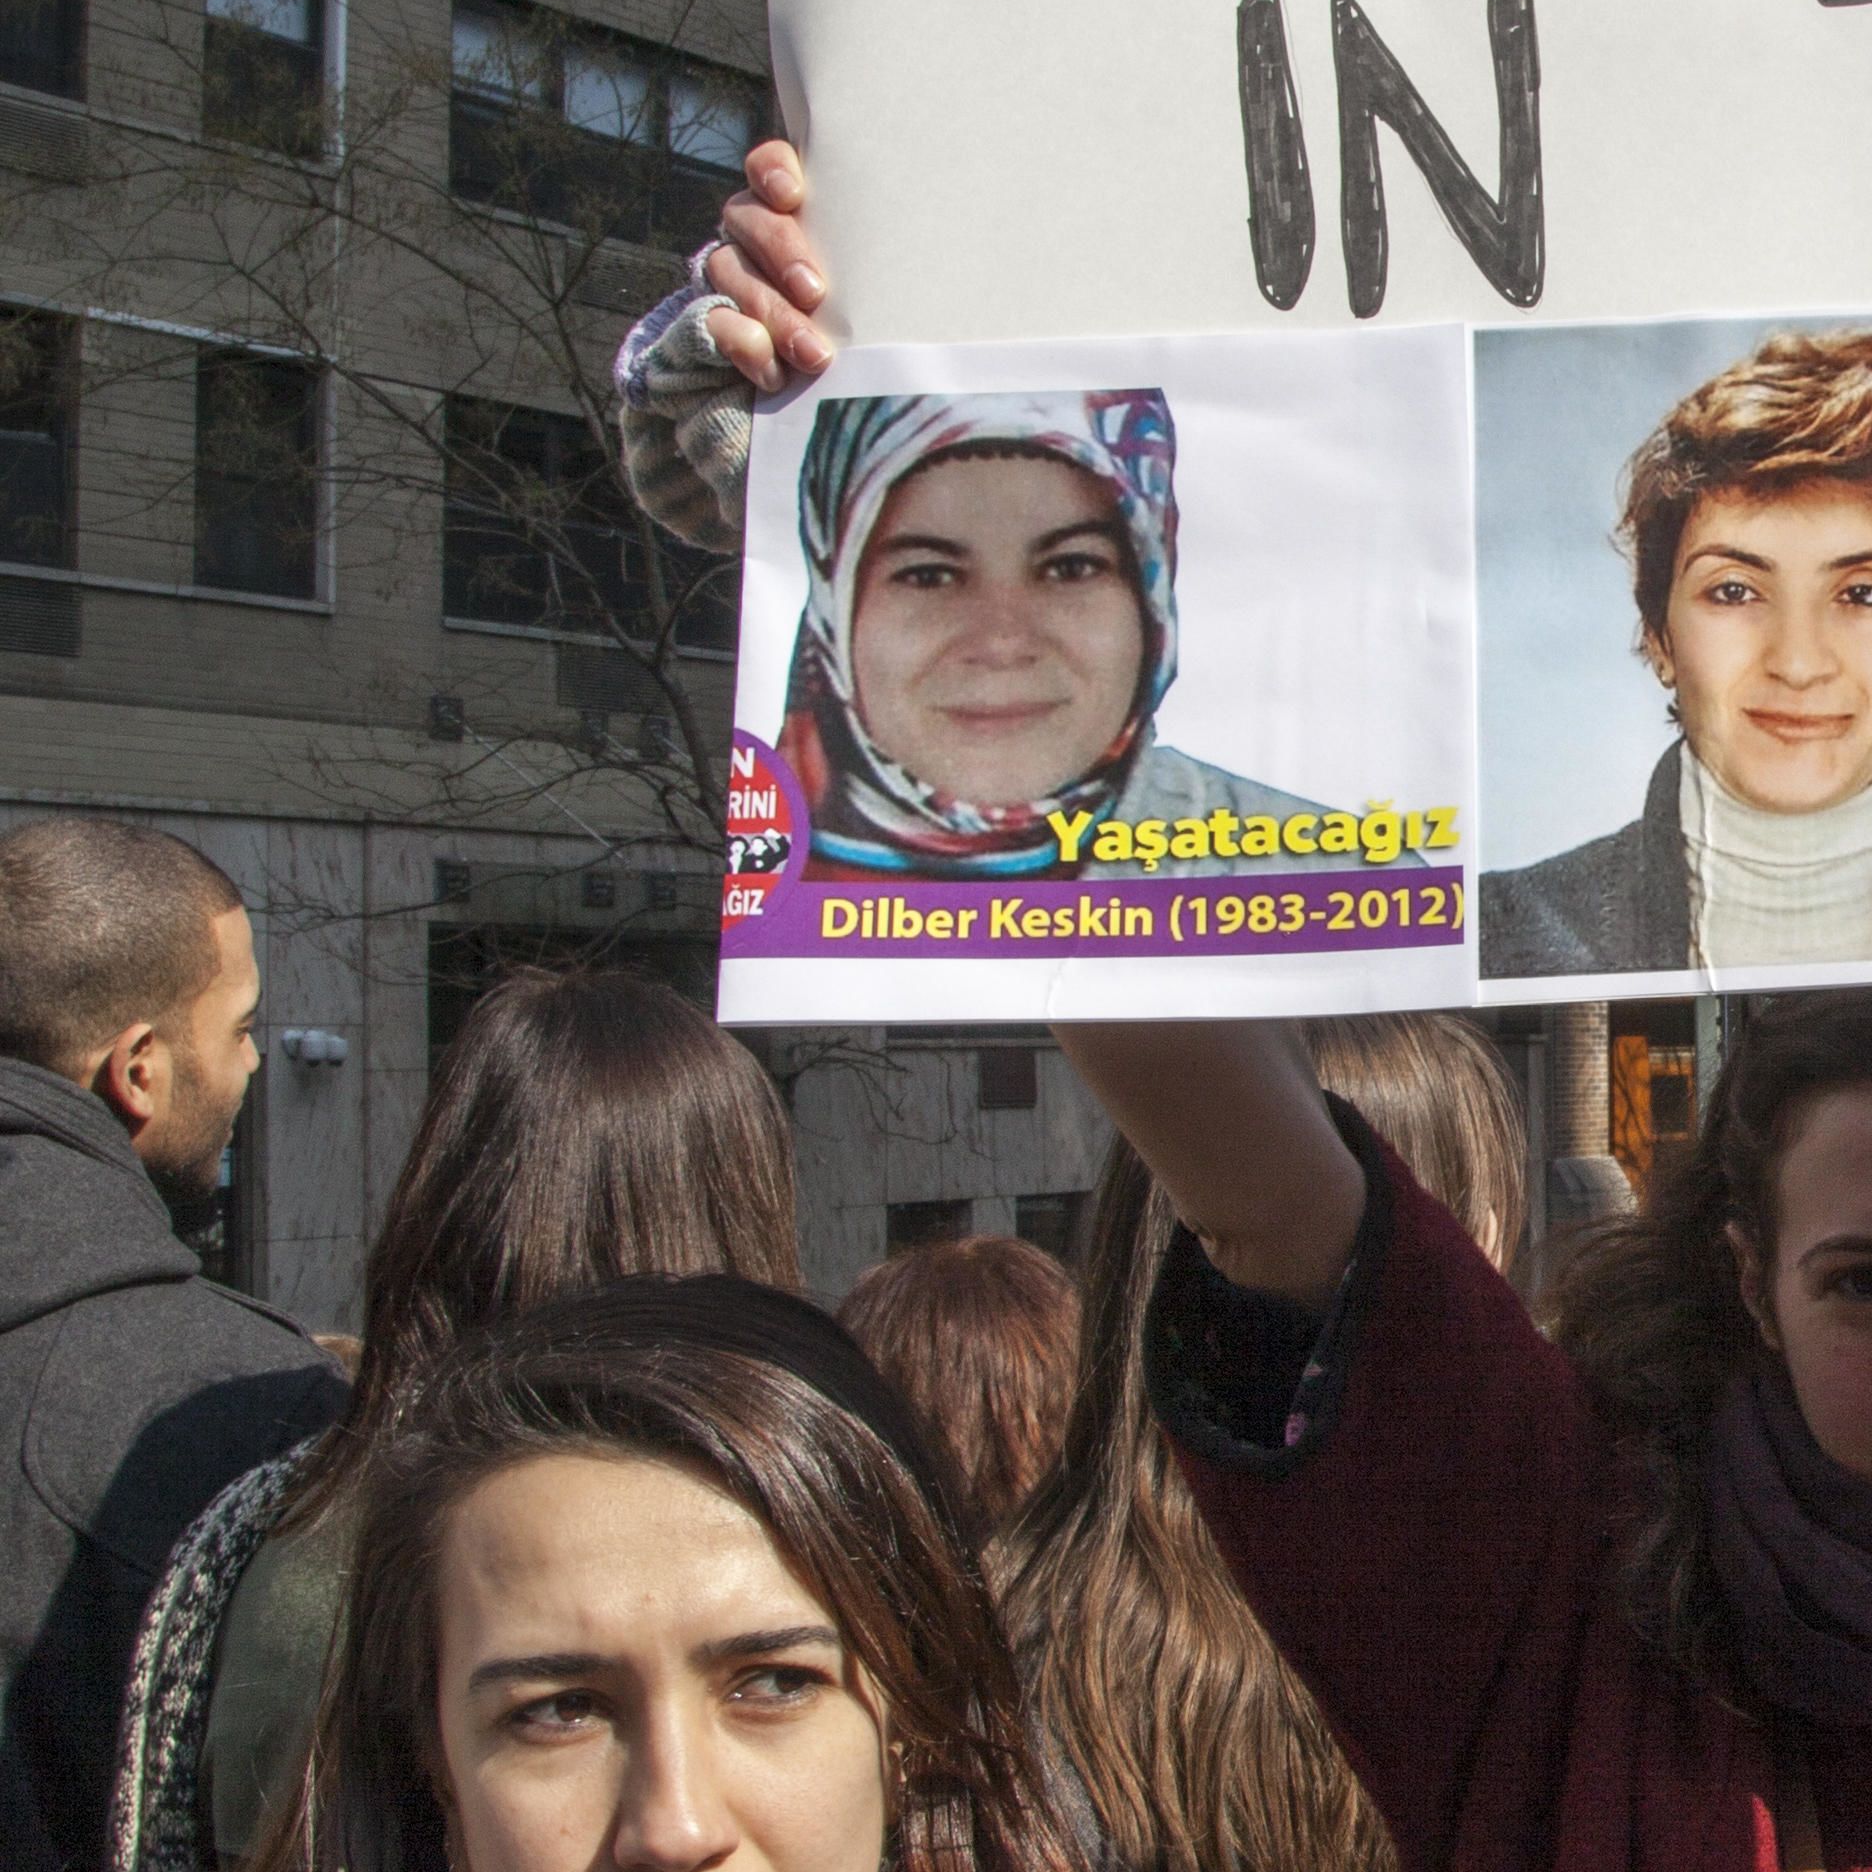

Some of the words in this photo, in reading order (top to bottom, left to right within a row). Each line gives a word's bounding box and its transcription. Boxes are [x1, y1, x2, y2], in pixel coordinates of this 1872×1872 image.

[1046, 799, 1461, 872] Yaşatacağız
[821, 897, 978, 939] Dilber
[990, 896, 1153, 938] Keskin
[1169, 883, 1464, 942] (1983-2012)
